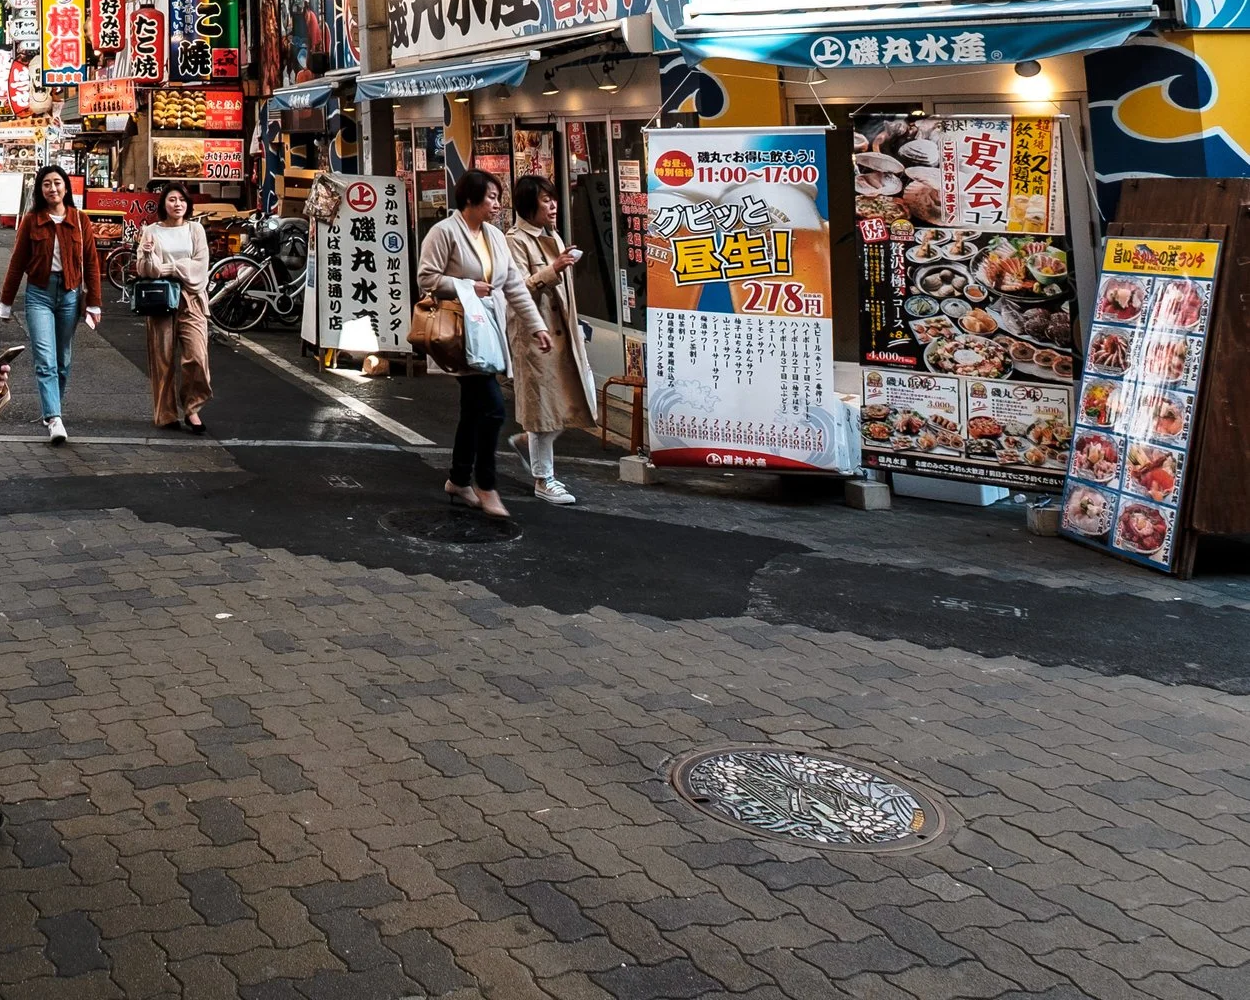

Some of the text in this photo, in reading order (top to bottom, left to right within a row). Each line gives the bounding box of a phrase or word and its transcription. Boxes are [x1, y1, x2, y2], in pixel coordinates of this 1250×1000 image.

[47, 6, 84, 69] 横綱
[134, 15, 159, 80] たこ焼
[847, 31, 987, 64] 磯丸水産
[970, 118, 1009, 133] 海の幸
[206, 163, 241, 178] 500円
[655, 168, 694, 178] 特別価格
[662, 158, 686, 168] お昼は
[697, 150, 815, 164] 磯丸でお得に飲もう!
[962, 133, 1006, 209] 宴会
[1013, 123, 1033, 195] 飲み放題付
[943, 141, 957, 224] ご予約承ります!
[384, 184, 399, 226] さかな
[653, 195, 771, 238] グビッと
[965, 210, 1007, 225] コース
[326, 222, 343, 331] んば南海通り店
[672, 230, 792, 284] 昼生!
[386, 257, 402, 346] 加工センター
[743, 282, 824, 315] 278円
[893, 299, 905, 329] コース
[656, 312, 664, 377] ソフトドリンク各種
[678, 313, 686, 342] 緑茶割り
[689, 314, 697, 365] ウーロン茶割り
[700, 316, 708, 351] 梅酒サワー
[723, 317, 731, 368] 山ぶどうサワー
[757, 319, 765, 363] レモンサワー
[768, 320, 776, 357] チューハイ
